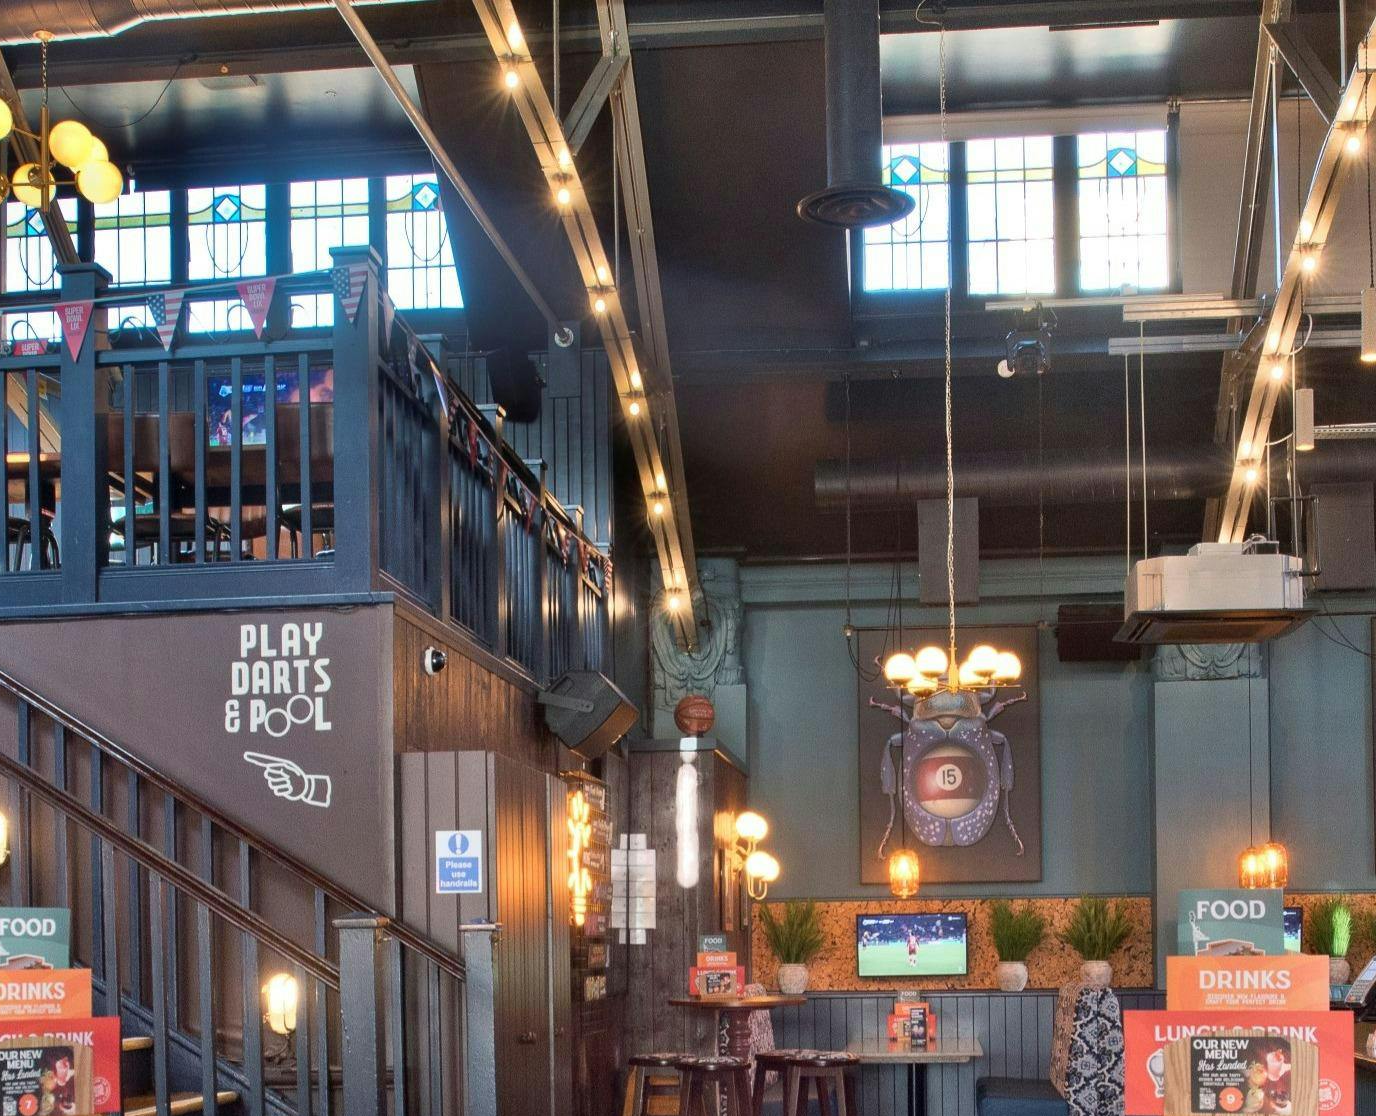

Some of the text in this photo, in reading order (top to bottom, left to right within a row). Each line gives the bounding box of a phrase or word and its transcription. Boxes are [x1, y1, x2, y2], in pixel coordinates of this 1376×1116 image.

[247, 284, 266, 293] SUPER
[64, 307, 84, 315] SUPER
[240, 622, 323, 658] PLAY
[231, 658, 332, 695] DARTS
[225, 694, 332, 737] & POOL
[942, 768, 956, 785] 15
[445, 861, 472, 869] Please
[440, 879, 478, 888] handrails
[1196, 900, 1266, 920] FOOD
[0, 918, 56, 937] FOOD
[1199, 970, 1291, 990] DRINKS
[1193, 1040, 1249, 1050] OUR NEW
[20, 1050, 42, 1060] NEW
[1205, 1050, 1238, 1059] MENU
[7, 1060, 34, 1069] MENU
[1198, 1059, 1247, 1071] Has Landed
